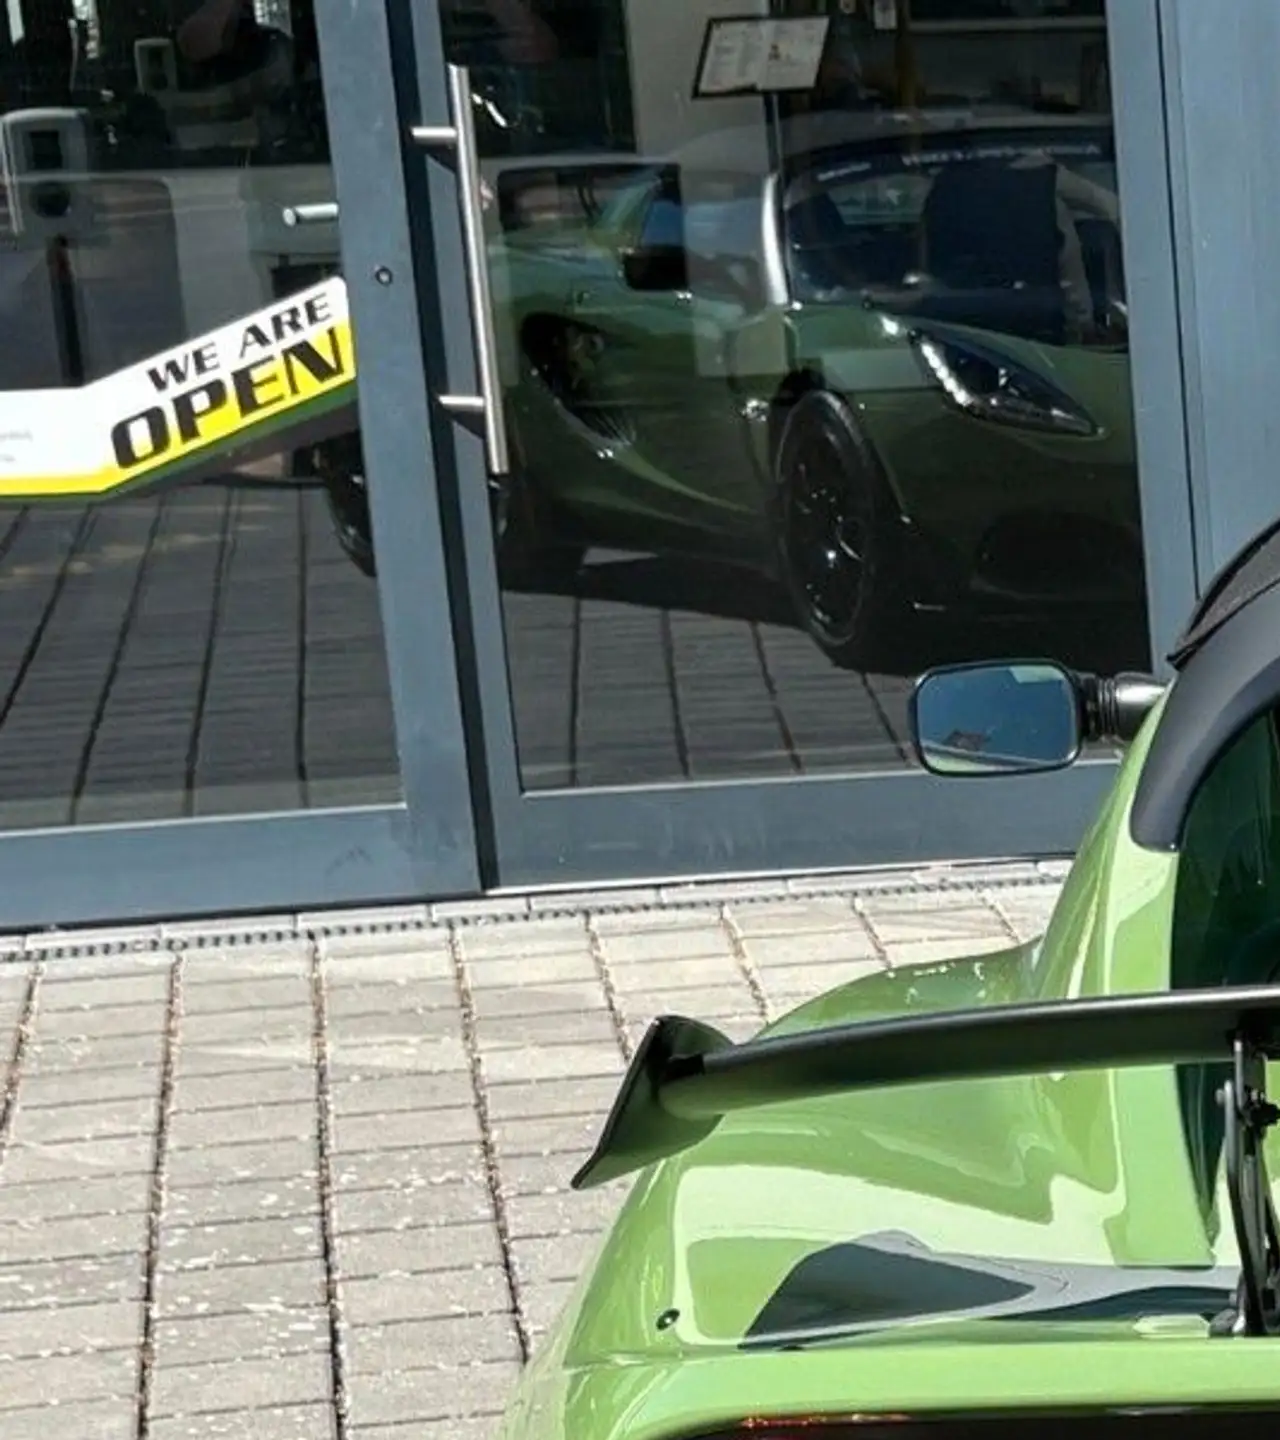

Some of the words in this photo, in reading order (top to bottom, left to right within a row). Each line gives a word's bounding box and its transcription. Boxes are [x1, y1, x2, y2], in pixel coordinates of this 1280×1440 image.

[111, 326, 345, 469] OPEN
[147, 340, 219, 392] WE
[240, 293, 332, 358] ARE
